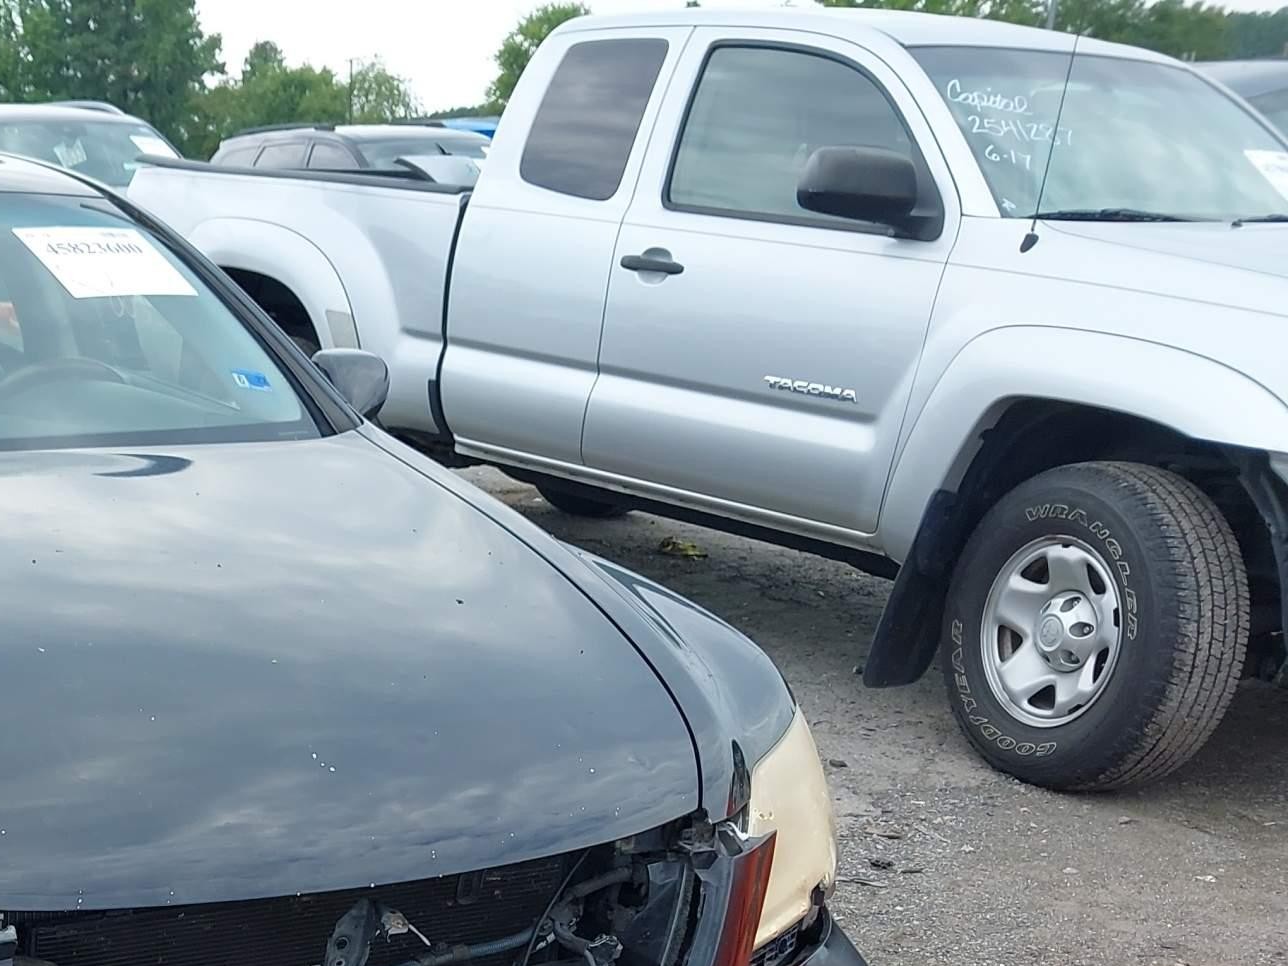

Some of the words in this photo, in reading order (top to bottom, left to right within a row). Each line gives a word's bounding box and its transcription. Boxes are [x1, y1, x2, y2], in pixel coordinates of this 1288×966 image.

[45, 241, 144, 256] 45823600
[763, 375, 858, 403] TACOMA
[1024, 502, 1138, 642] WRANGLER
[950, 618, 1058, 757] GOODYEAR
